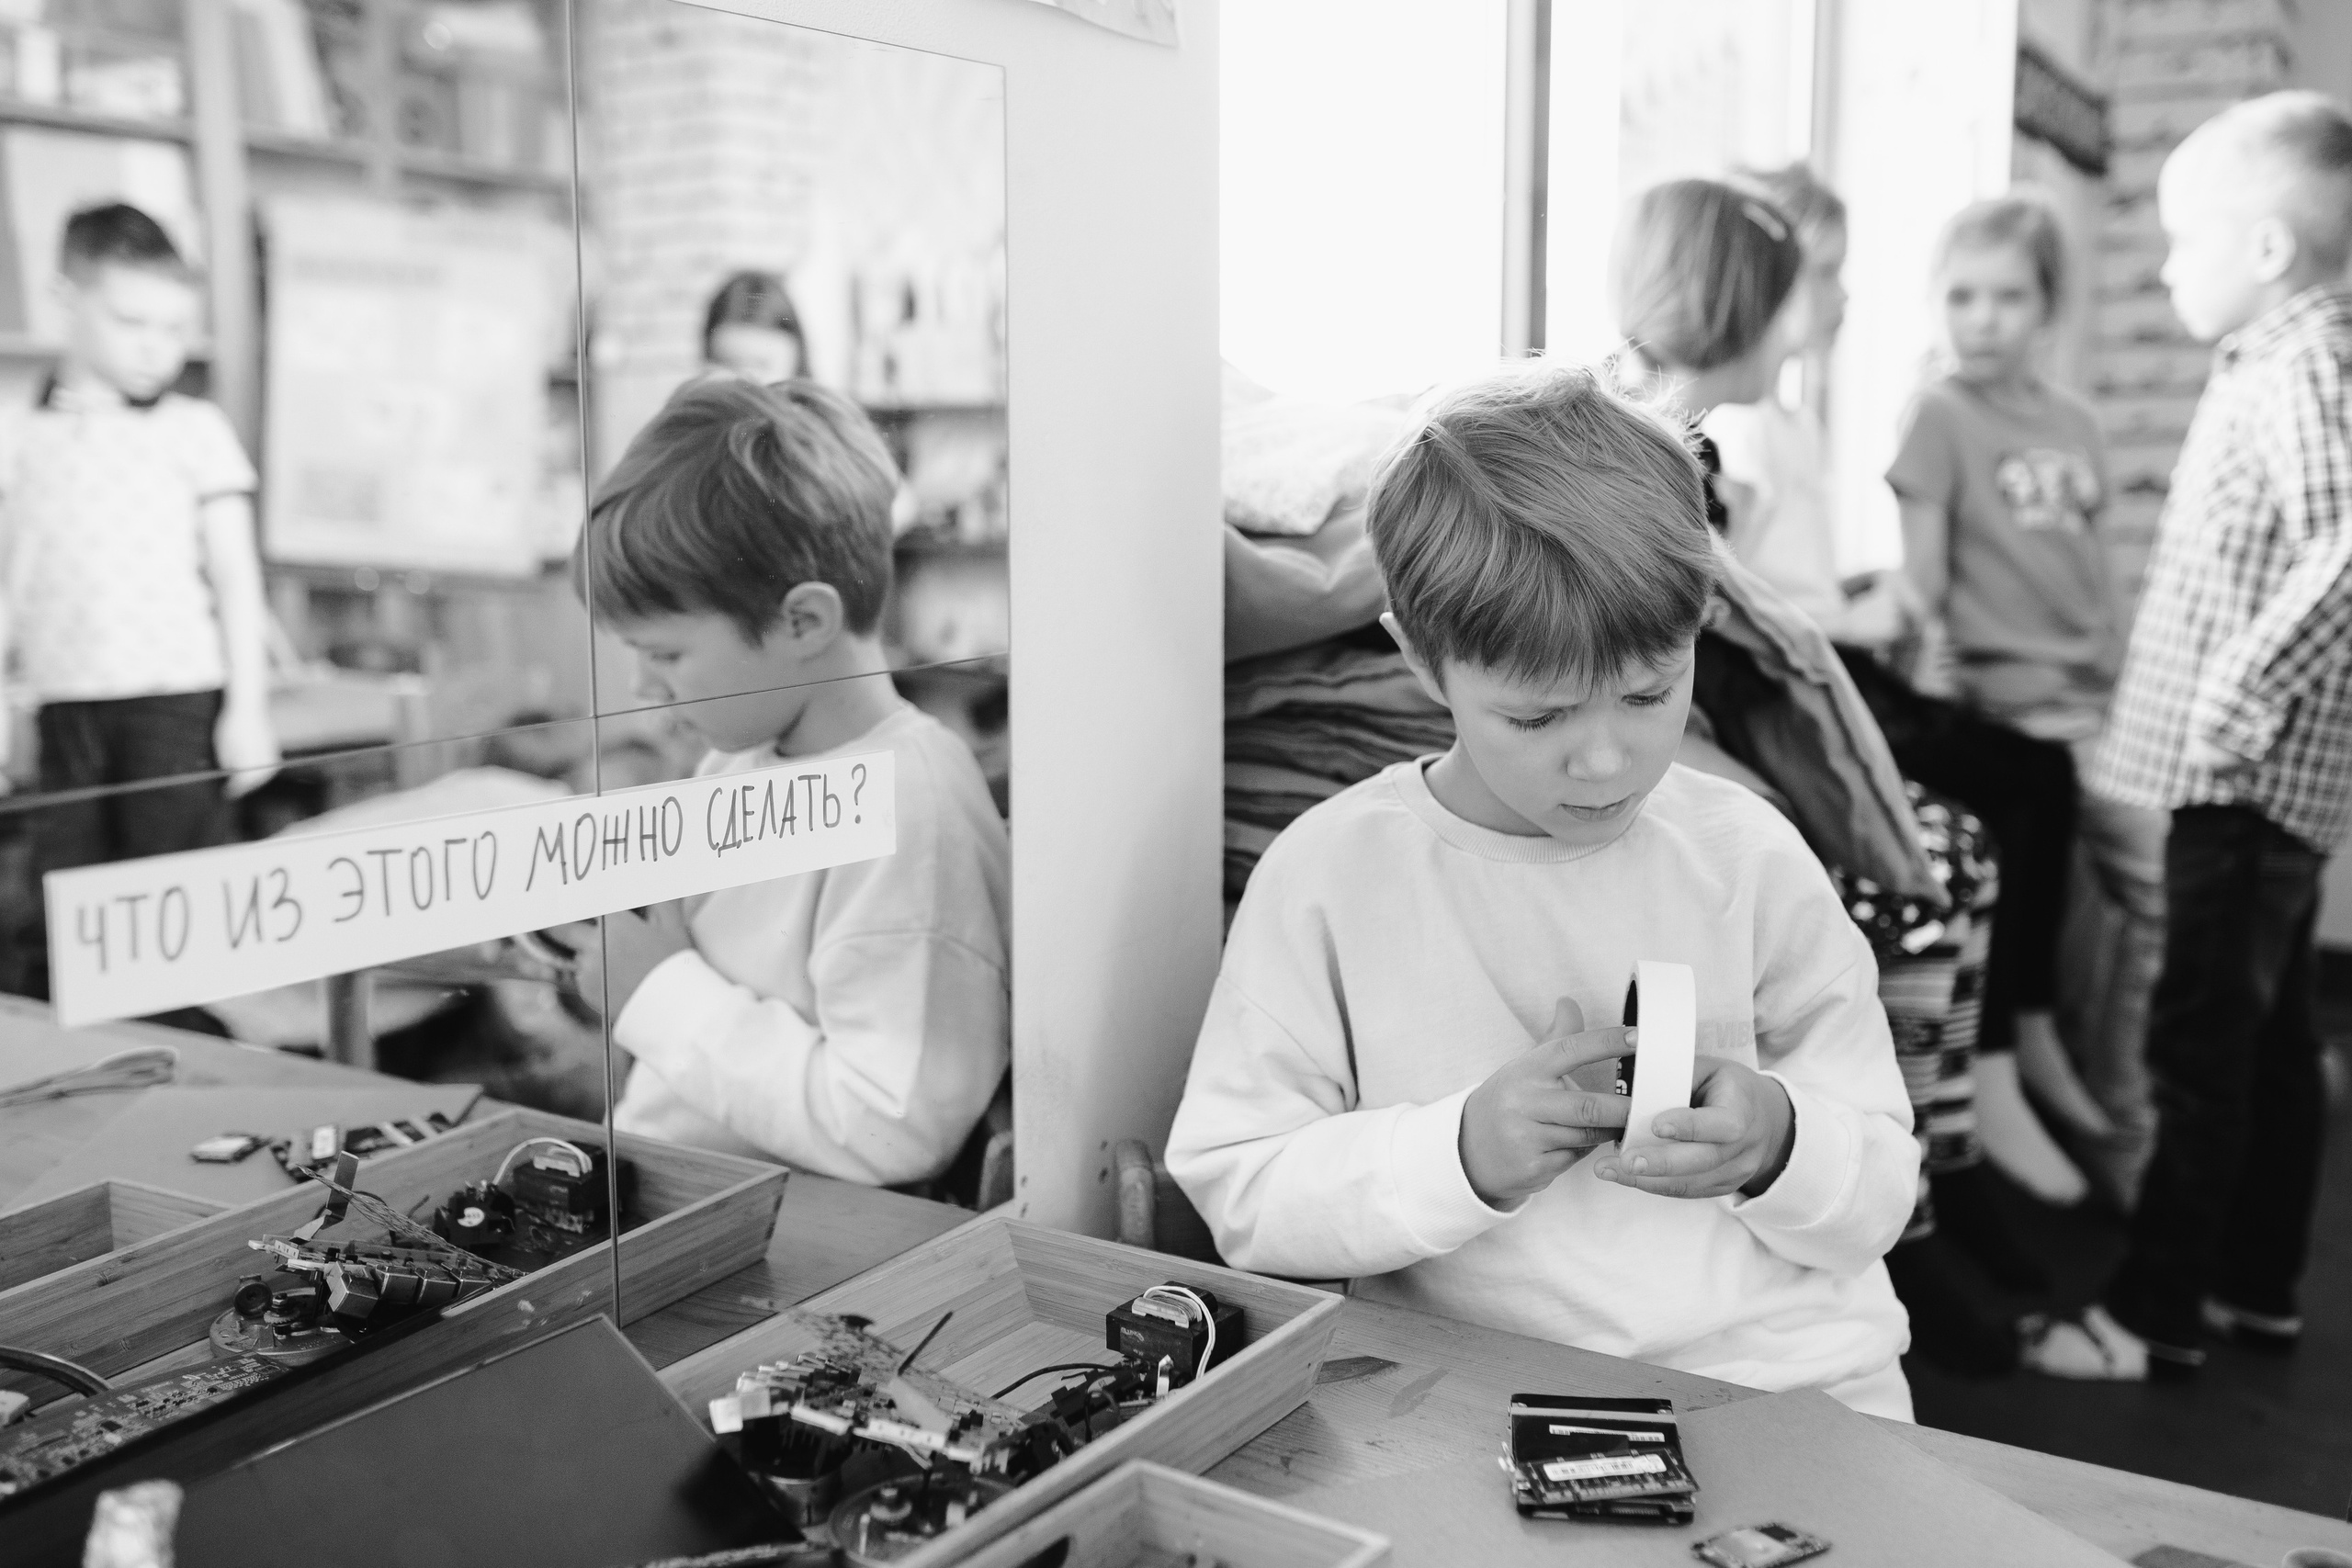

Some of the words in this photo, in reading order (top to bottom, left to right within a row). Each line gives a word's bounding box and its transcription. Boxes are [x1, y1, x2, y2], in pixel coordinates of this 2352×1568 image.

[76, 885, 190, 974] ЧТО
[222, 866, 303, 950] ИЗ
[328, 830, 497, 923] ЭТОГО
[526, 795, 684, 892] МОЖНО
[707, 763, 867, 858] СДЕЛАТЬ?
